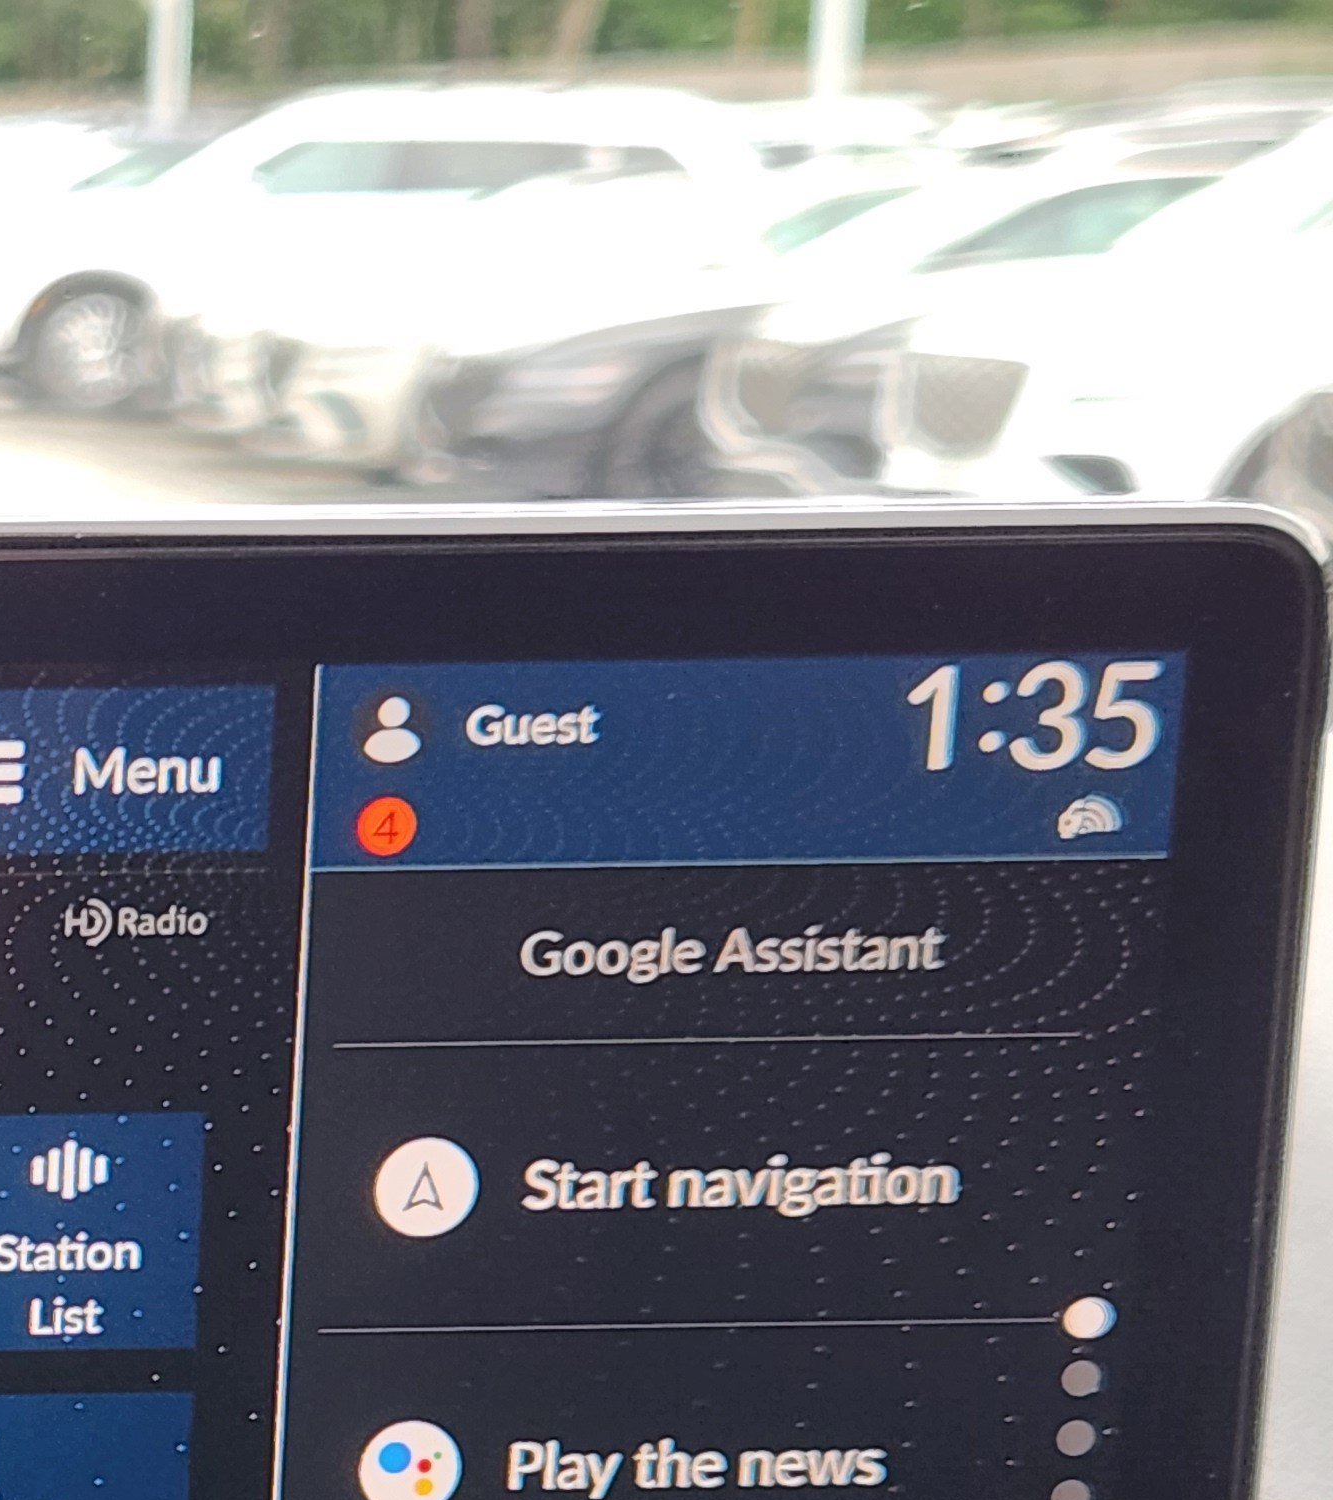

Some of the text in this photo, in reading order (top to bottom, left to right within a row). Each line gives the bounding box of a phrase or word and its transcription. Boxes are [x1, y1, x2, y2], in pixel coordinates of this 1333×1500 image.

[464, 703, 602, 749] Guest
[906, 659, 1166, 772] 1:35
[72, 748, 224, 796] Menu
[374, 809, 400, 848] 4
[116, 904, 209, 940] Radio
[520, 923, 947, 984] Google Assistant
[520, 1153, 961, 1217] Start navigation
[27, 1298, 105, 1337] List
[505, 1438, 888, 1500] Play the news
